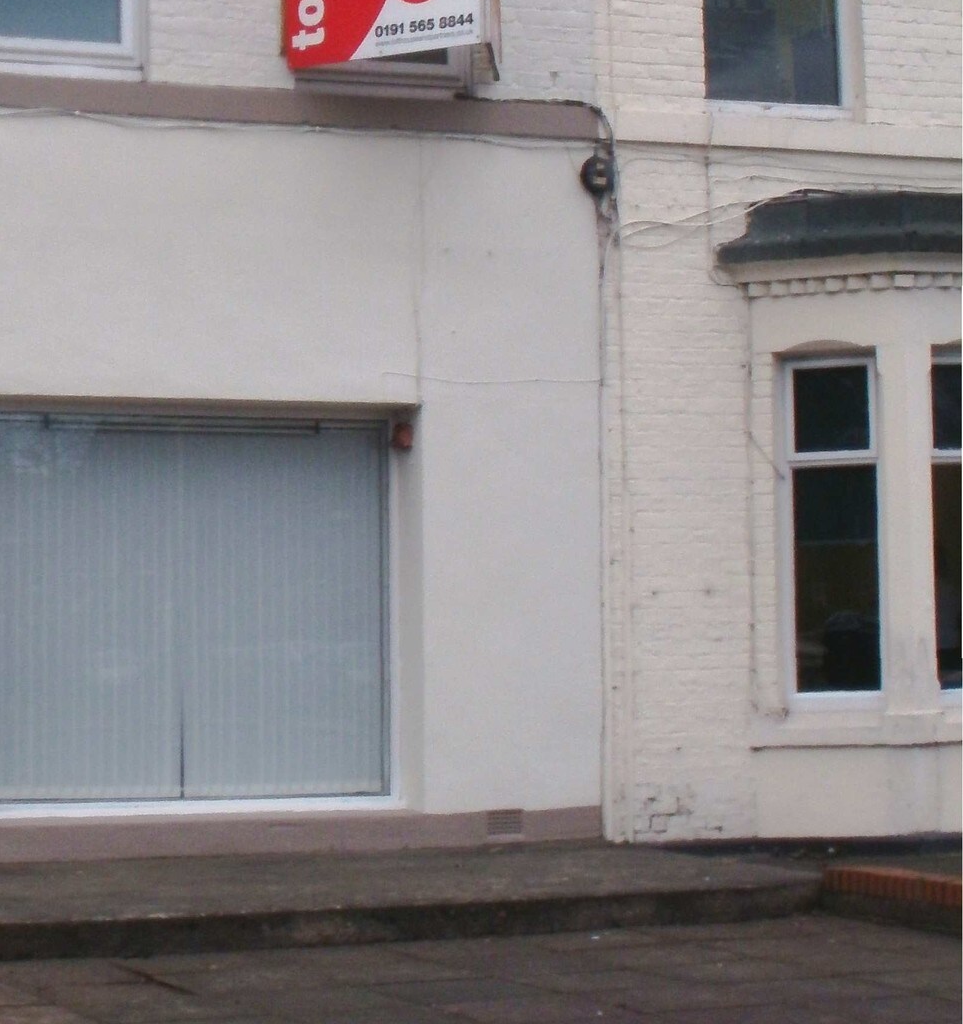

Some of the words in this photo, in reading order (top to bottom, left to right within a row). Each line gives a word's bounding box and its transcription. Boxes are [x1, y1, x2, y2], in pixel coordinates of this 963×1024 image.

[375, 23, 404, 38] 0191
[409, 18, 435, 33] 565
[439, 13, 474, 29] 8844
